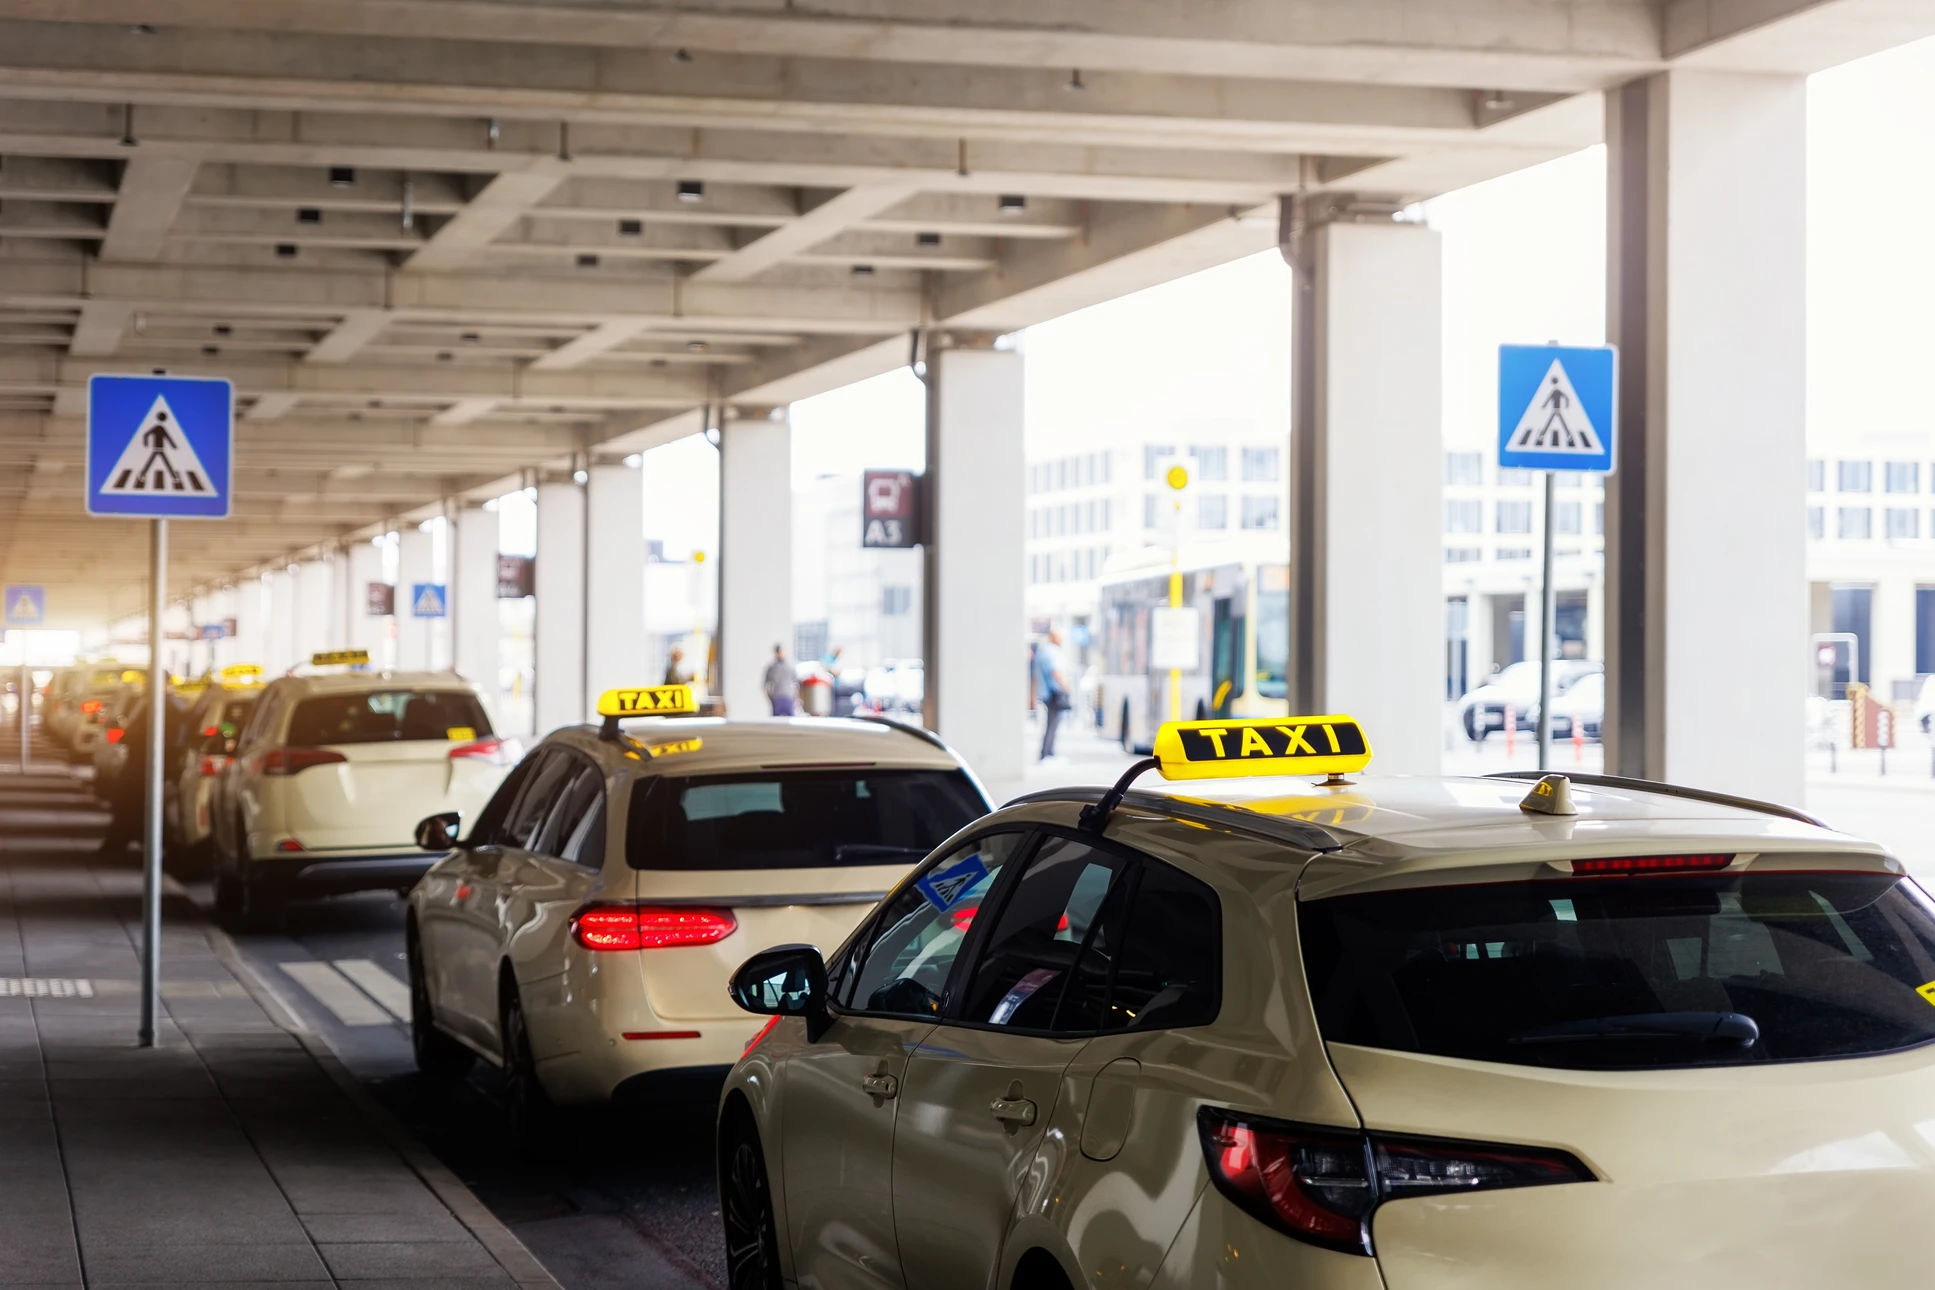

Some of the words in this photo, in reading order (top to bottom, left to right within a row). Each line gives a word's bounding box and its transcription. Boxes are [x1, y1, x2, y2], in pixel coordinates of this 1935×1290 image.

[865, 519, 903, 546] A3
[619, 690, 683, 710] TAXI
[1199, 724, 1341, 757] TAXI
